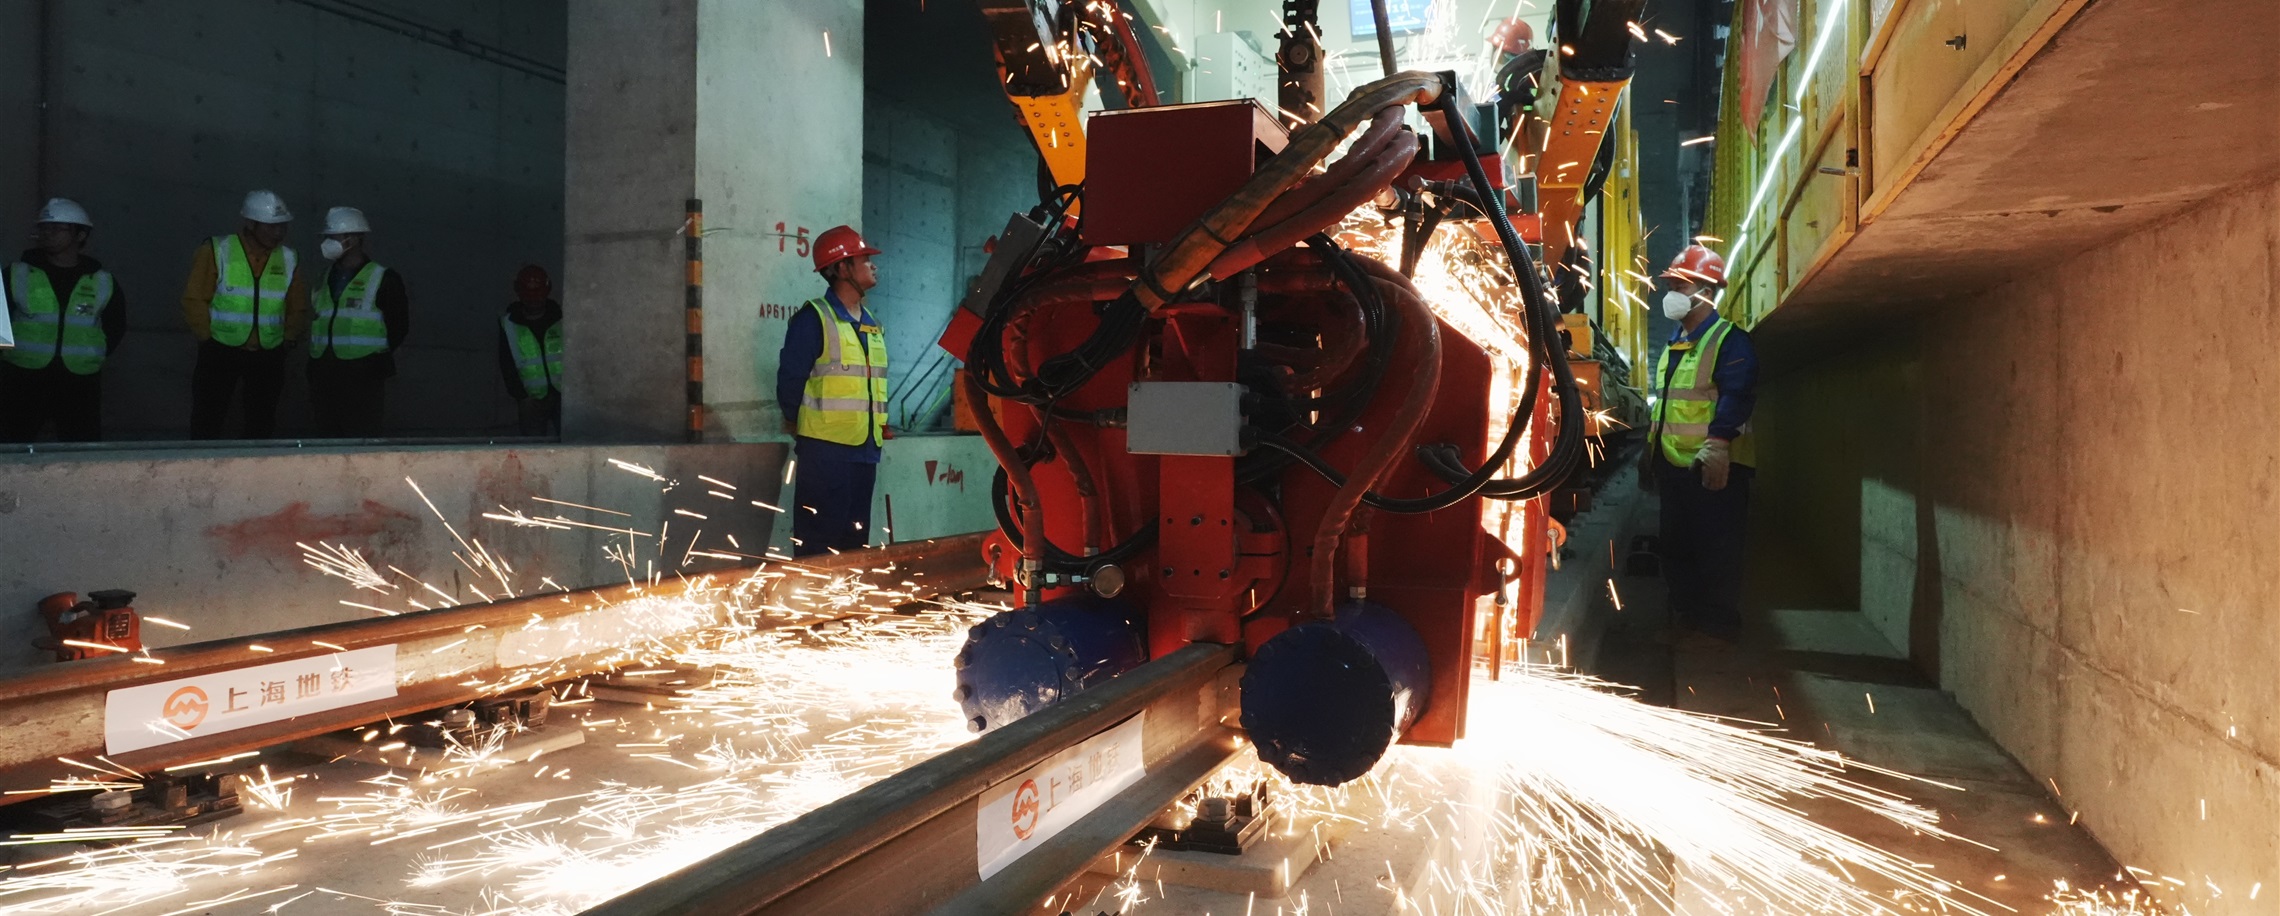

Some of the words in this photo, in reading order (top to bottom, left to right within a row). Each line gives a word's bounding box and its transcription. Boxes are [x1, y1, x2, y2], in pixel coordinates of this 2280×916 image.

[775, 221, 810, 258] 15
[222, 666, 353, 714] 上海地铁
